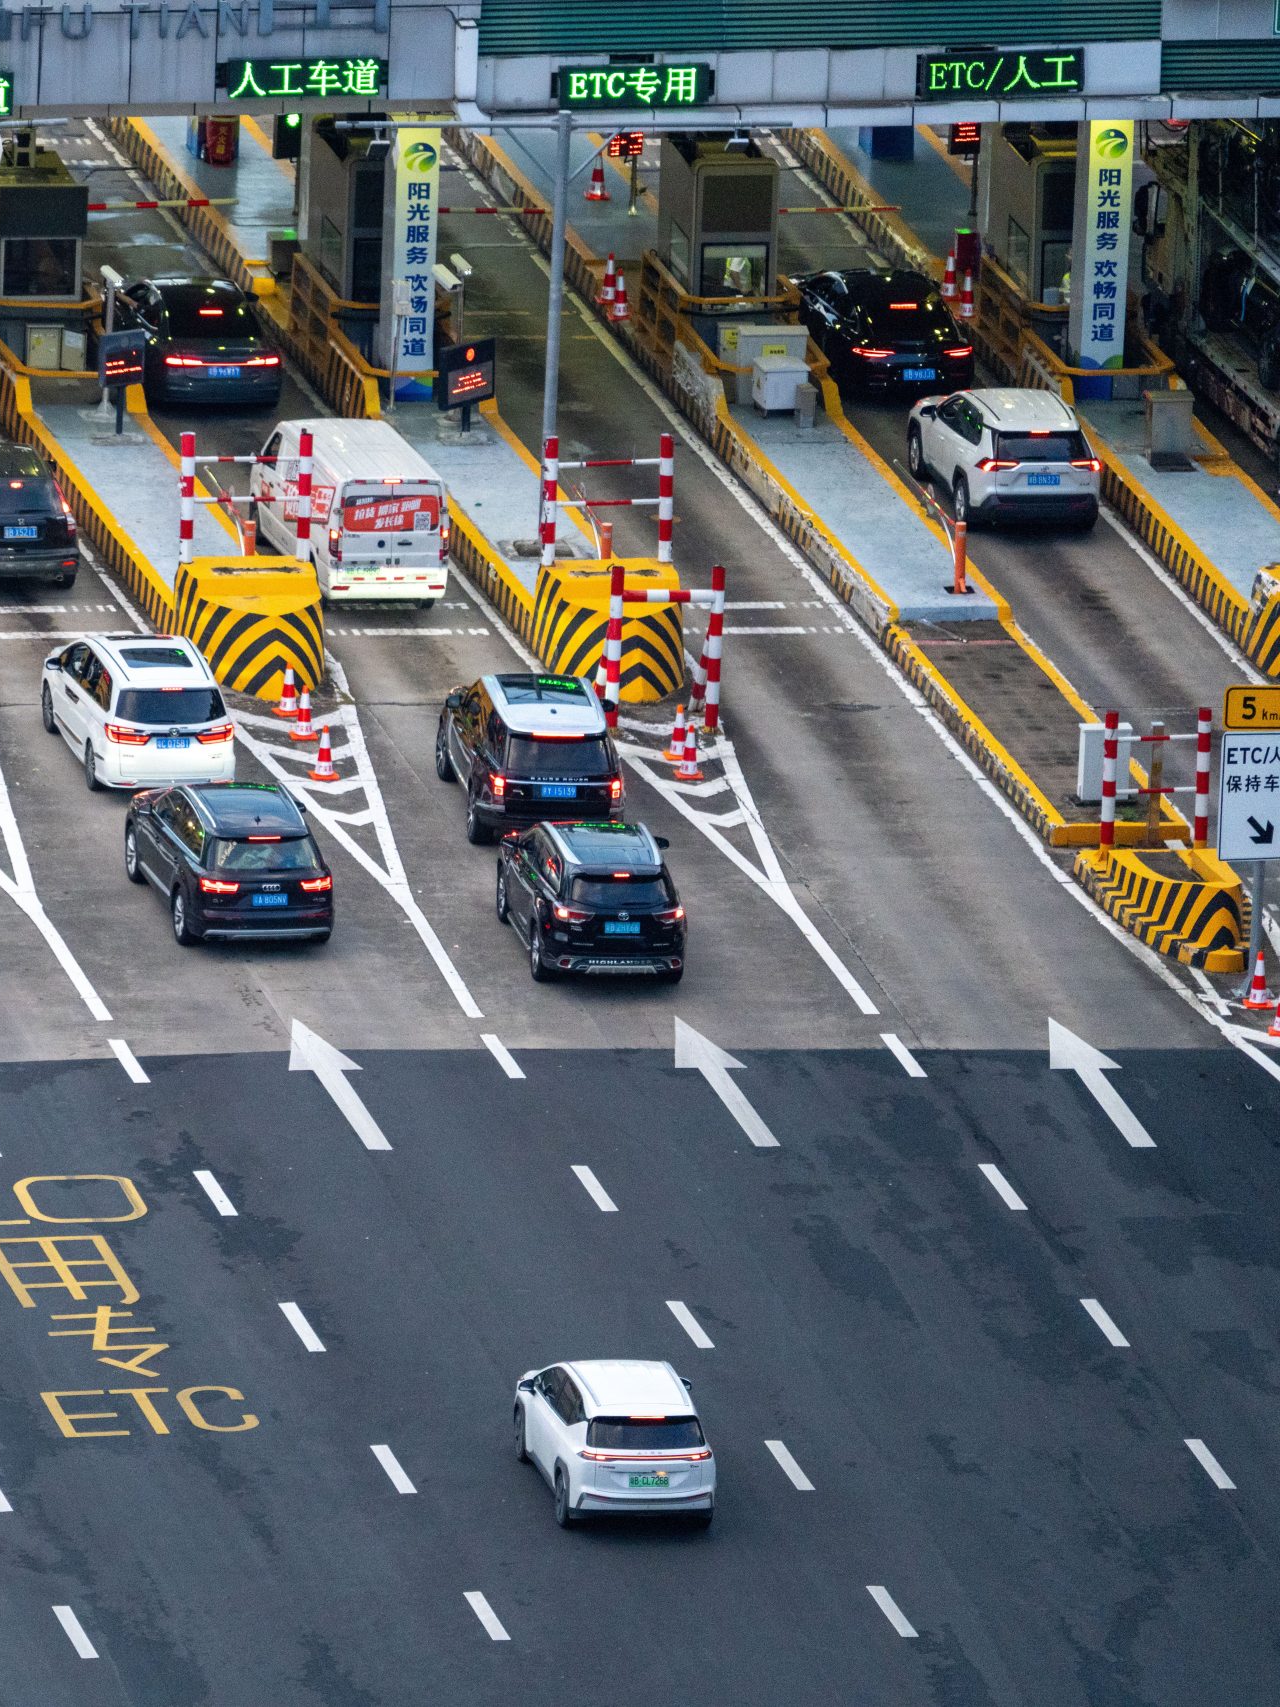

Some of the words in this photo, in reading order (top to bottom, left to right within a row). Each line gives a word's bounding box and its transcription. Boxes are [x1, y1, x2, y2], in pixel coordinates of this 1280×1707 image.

[229, 58, 380, 99] 人工车道
[568, 67, 696, 104] ETC专用
[929, 54, 1078, 92] ETC/人工
[1241, 695, 1257, 721] 5
[42, 1386, 258, 1438] ETC
